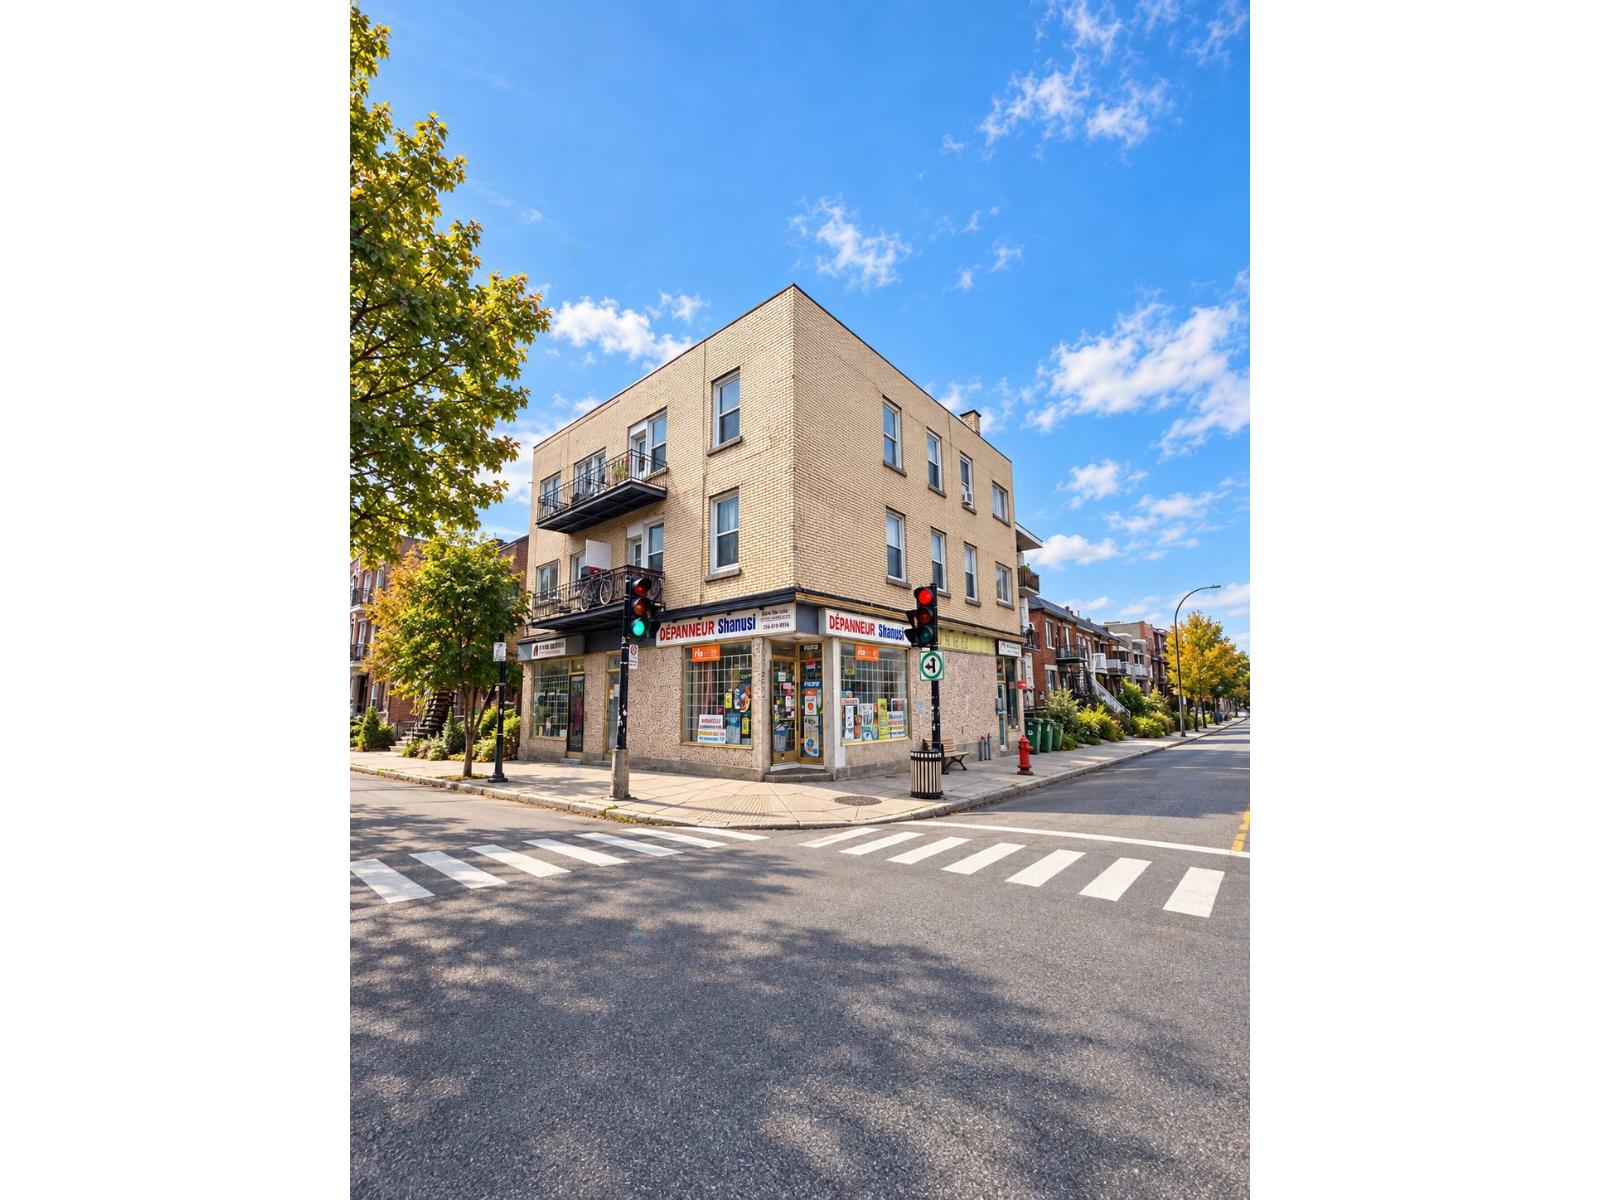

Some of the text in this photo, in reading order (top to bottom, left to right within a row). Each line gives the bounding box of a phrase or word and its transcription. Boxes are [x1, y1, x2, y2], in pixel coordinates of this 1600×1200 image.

[660, 613, 756, 641] DÉPANNEUR Shanusi
[829, 613, 905, 641] DÉPANNEUR Shanusi
